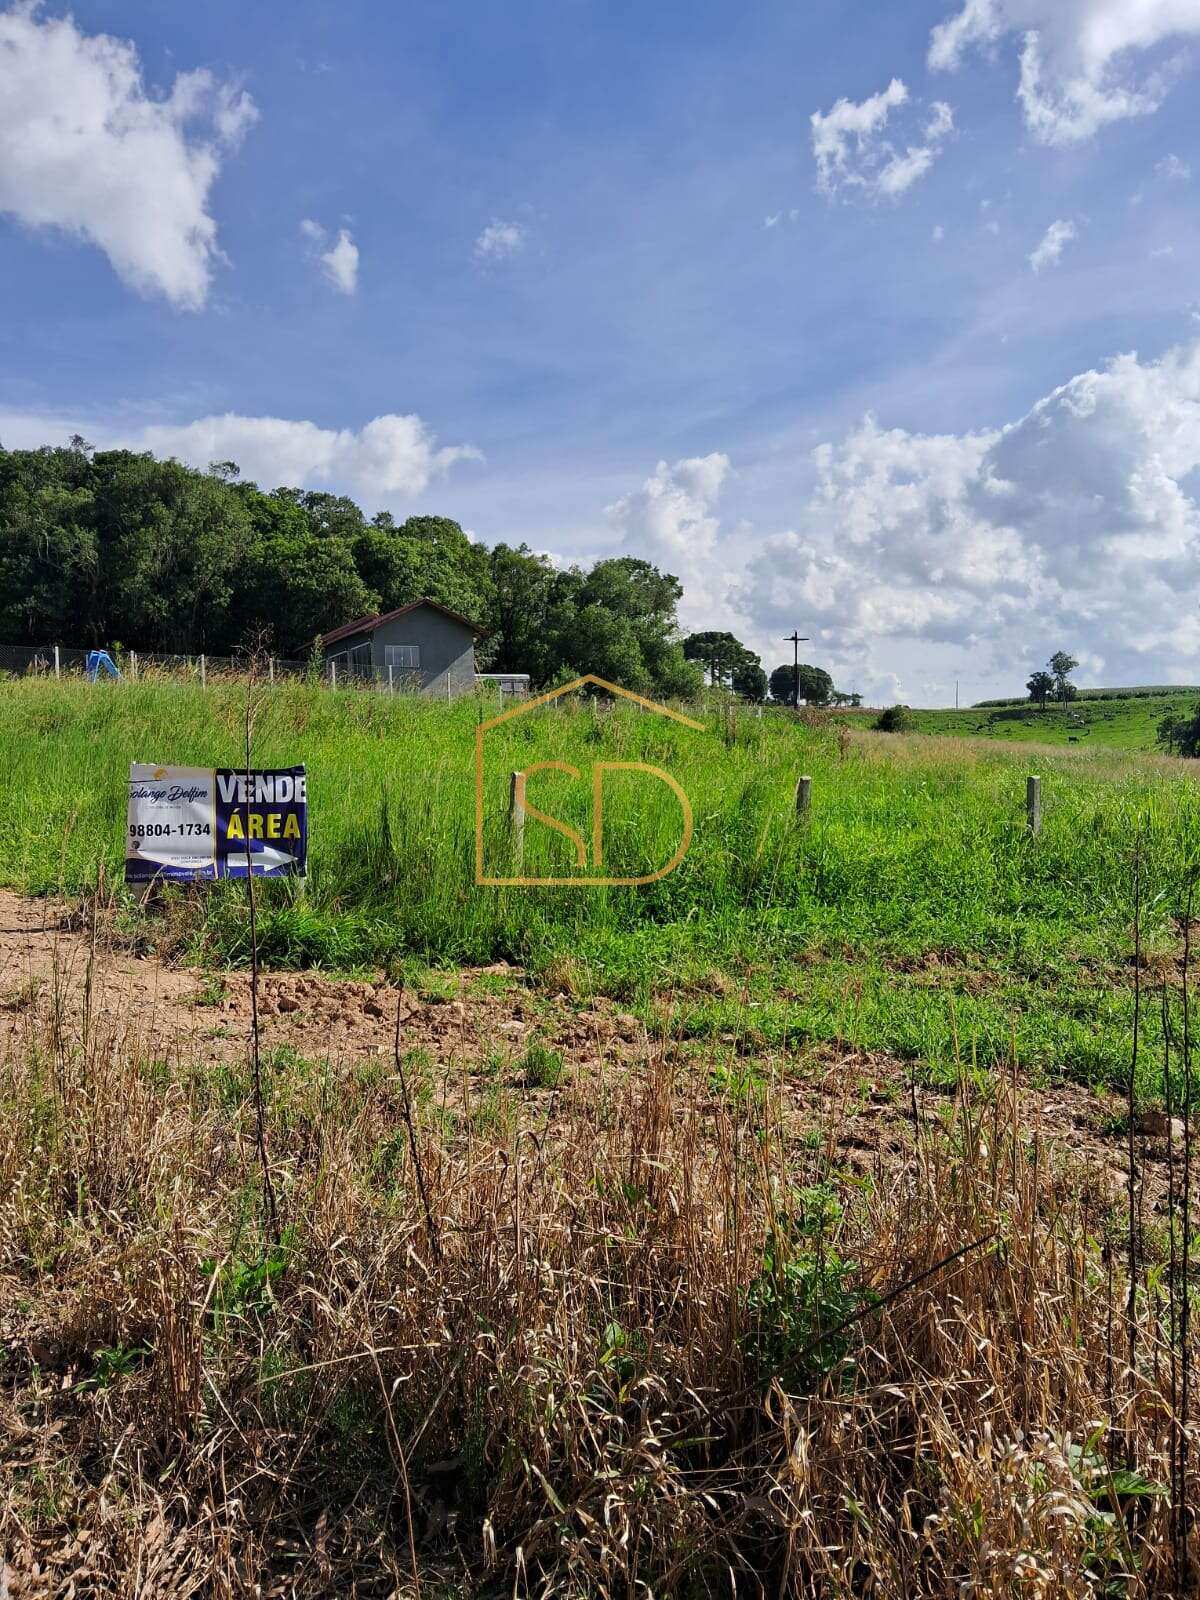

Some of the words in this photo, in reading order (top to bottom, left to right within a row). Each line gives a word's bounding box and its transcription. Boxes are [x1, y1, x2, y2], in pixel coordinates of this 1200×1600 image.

[167, 785, 208, 803] Delfim
[216, 775, 306, 803] VENDE
[129, 823, 211, 837] 98804-1734
[227, 807, 301, 839] ÁREA
